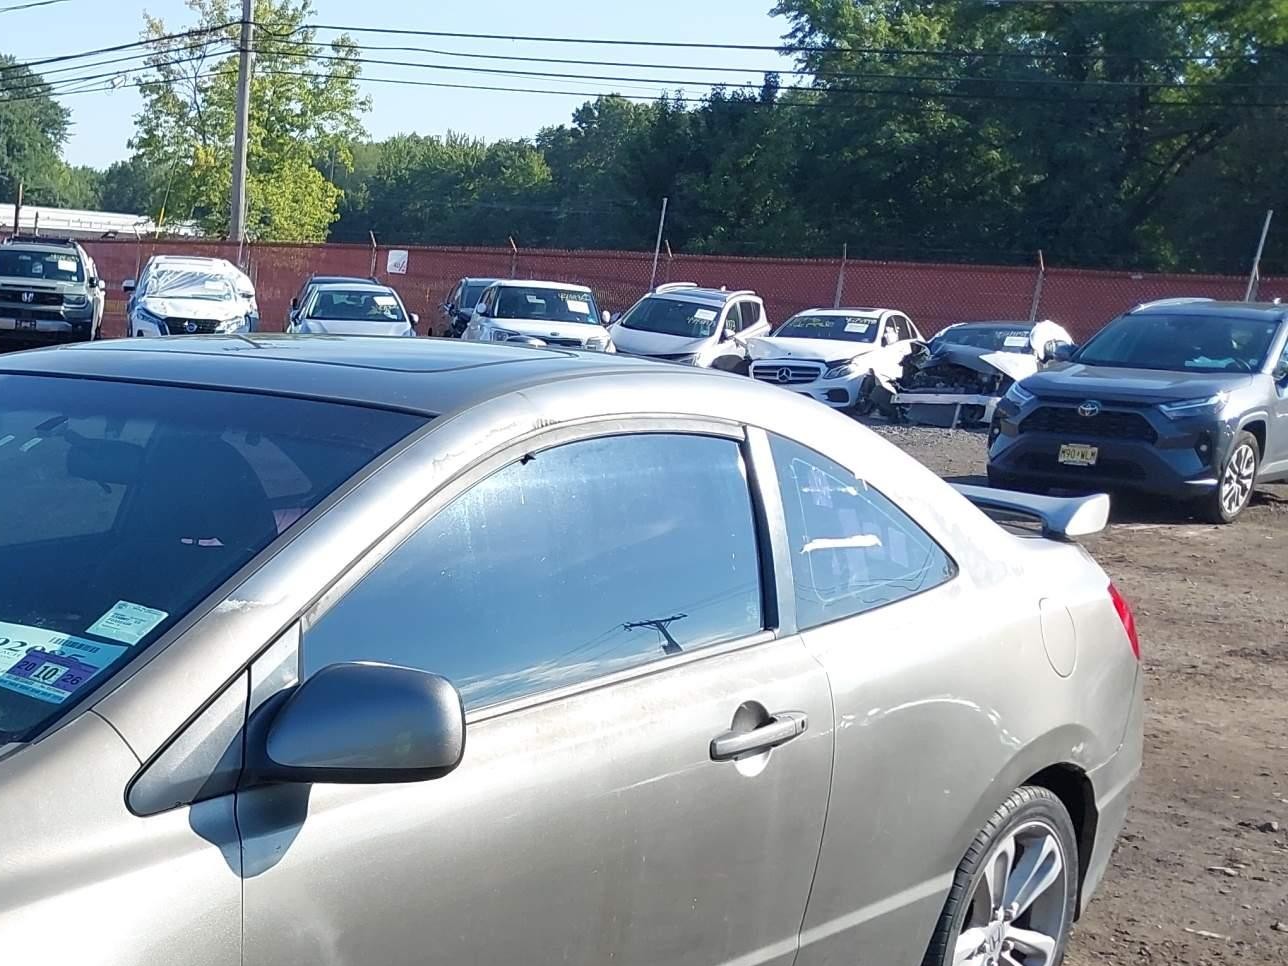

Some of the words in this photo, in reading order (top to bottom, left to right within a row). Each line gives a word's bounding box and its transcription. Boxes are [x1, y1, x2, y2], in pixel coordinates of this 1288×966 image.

[16, 661, 38, 673] 20
[36, 665, 58, 681] 10
[61, 673, 83, 686] 26
